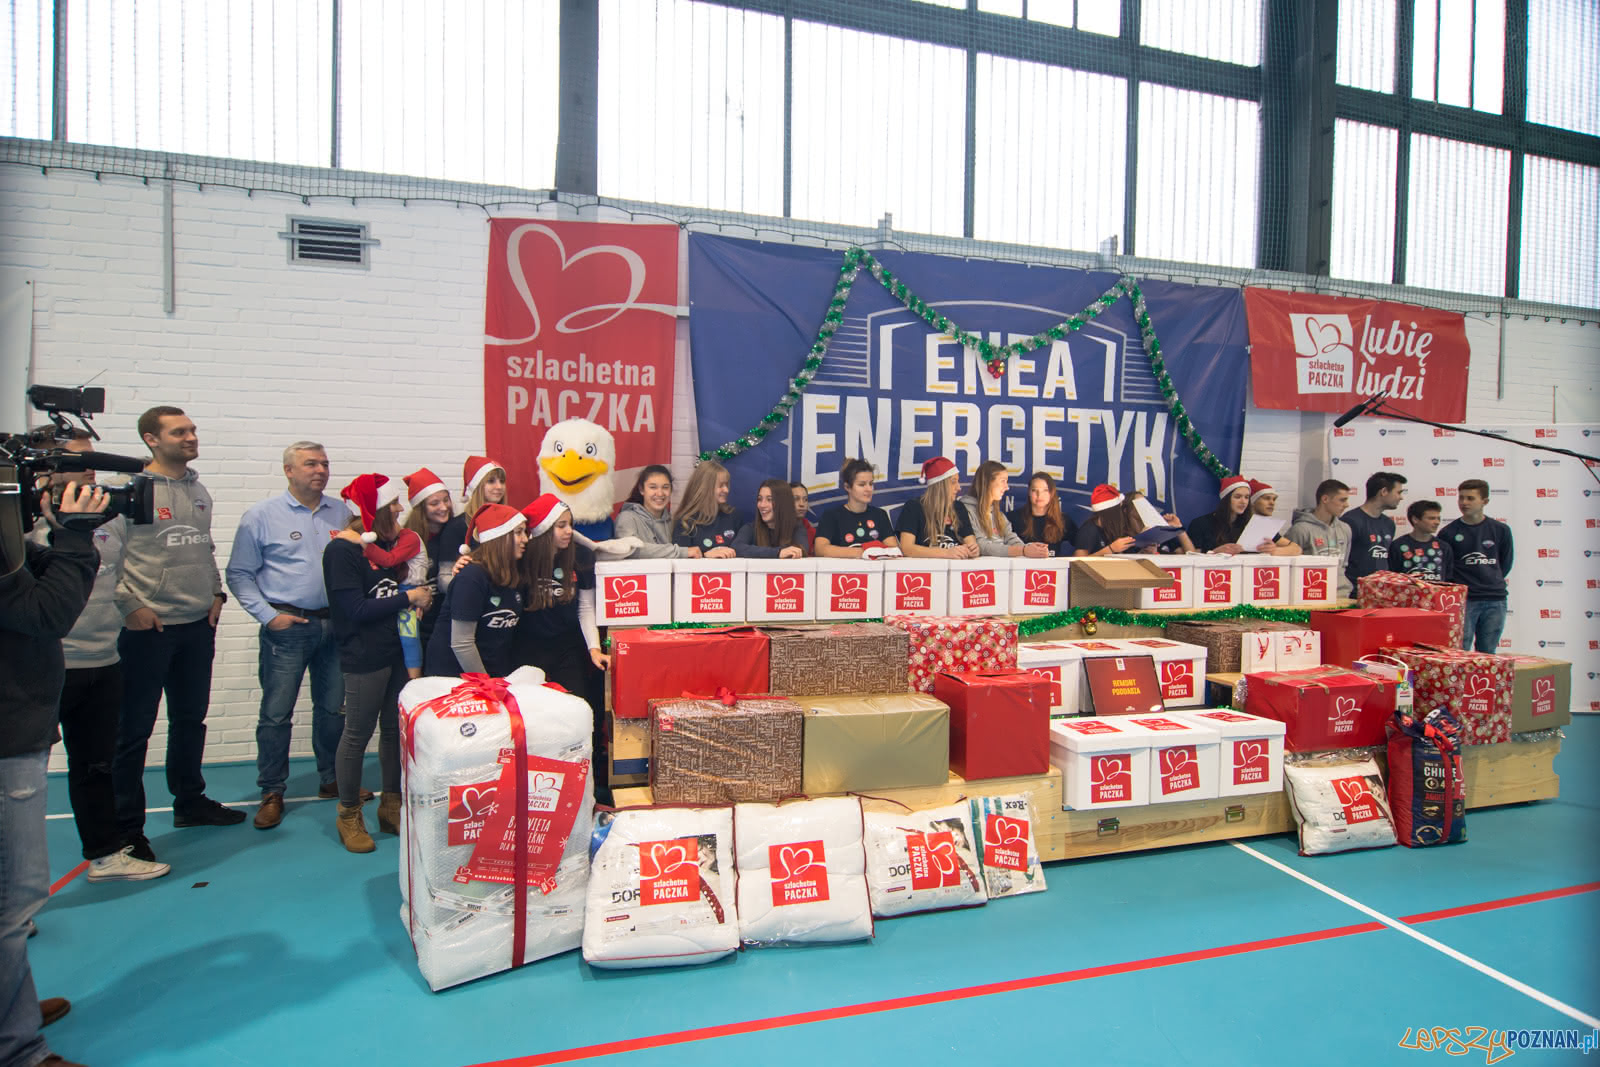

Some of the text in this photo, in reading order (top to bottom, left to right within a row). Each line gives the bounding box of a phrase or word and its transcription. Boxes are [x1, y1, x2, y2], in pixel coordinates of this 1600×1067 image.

[1360, 314, 1433, 366] Lubię
[507, 350, 656, 387] szlachetna
[926, 331, 1078, 400] ENEA
[1308, 359, 1345, 372] szlachetna
[1308, 371, 1344, 388] PACZKA
[1356, 362, 1426, 400] ludzi
[507, 385, 656, 433] PACZKA
[802, 393, 1169, 503] ENERGETYK
[167, 533, 209, 547] Enea
[1372, 549, 1389, 558] Ene
[614, 607, 640, 615] PACZKA
[774, 602, 797, 610] PACZKA
[1168, 689, 1188, 697] PACZKA
[450, 704, 488, 714] PACZKA
[1334, 724, 1353, 733] PACZKA
[1240, 772, 1262, 781] PACZKA
[1170, 779, 1192, 790] PACZKA
[1100, 790, 1124, 799] PACZKA
[1352, 810, 1373, 820] PACZKA
[912, 846, 924, 879] PACZKA
[994, 854, 1020, 867] PACZKA
[654, 879, 688, 888] szlachetna
[784, 881, 816, 889] szlachetna
[654, 886, 688, 900] PACZKA
[784, 888, 818, 900] PACZKA
